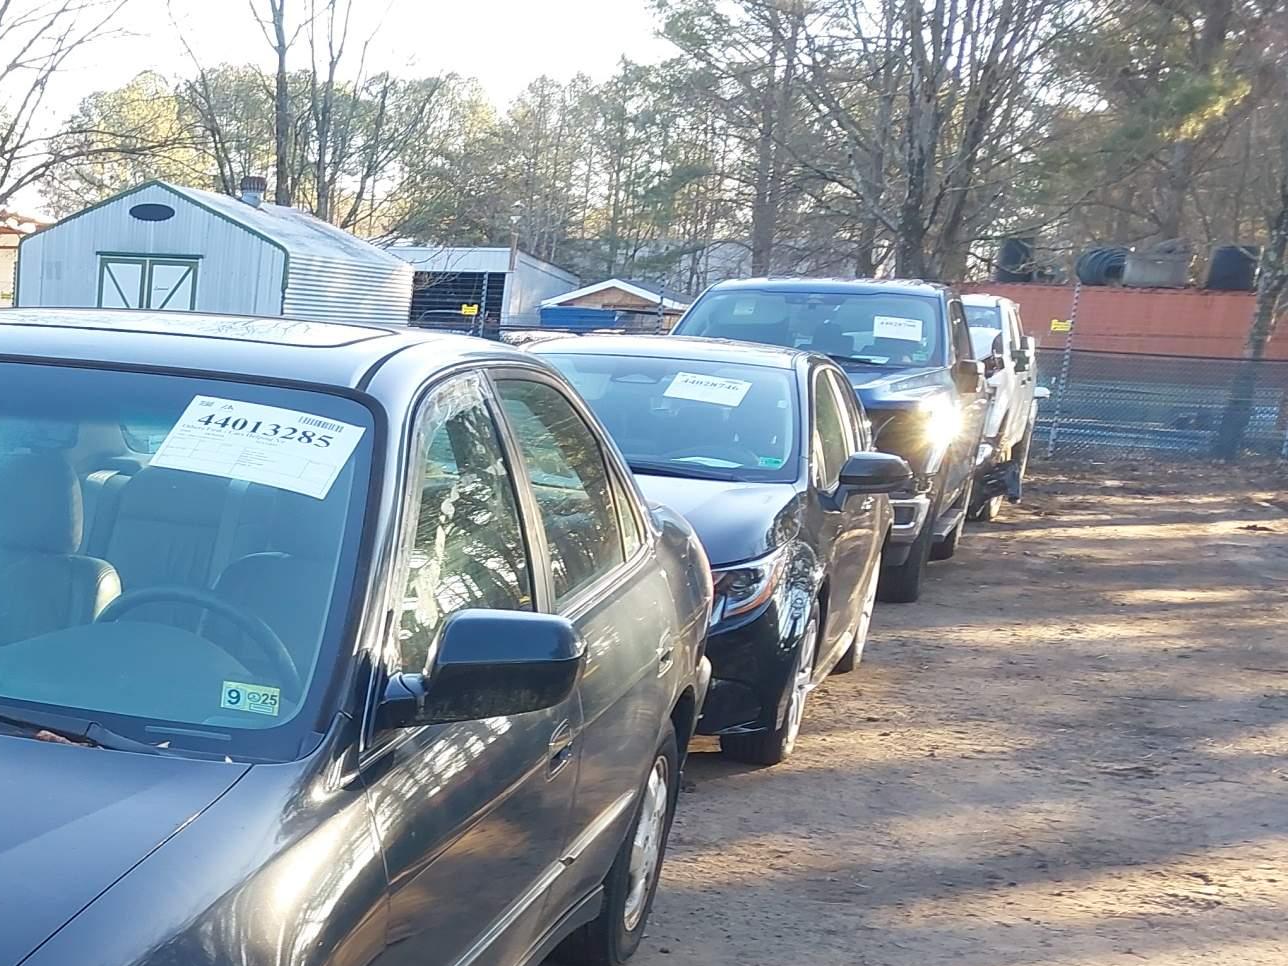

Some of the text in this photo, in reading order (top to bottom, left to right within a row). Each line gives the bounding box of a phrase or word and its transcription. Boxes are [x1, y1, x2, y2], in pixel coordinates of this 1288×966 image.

[197, 413, 335, 448] 44013285
[227, 689, 278, 706] 9 25
